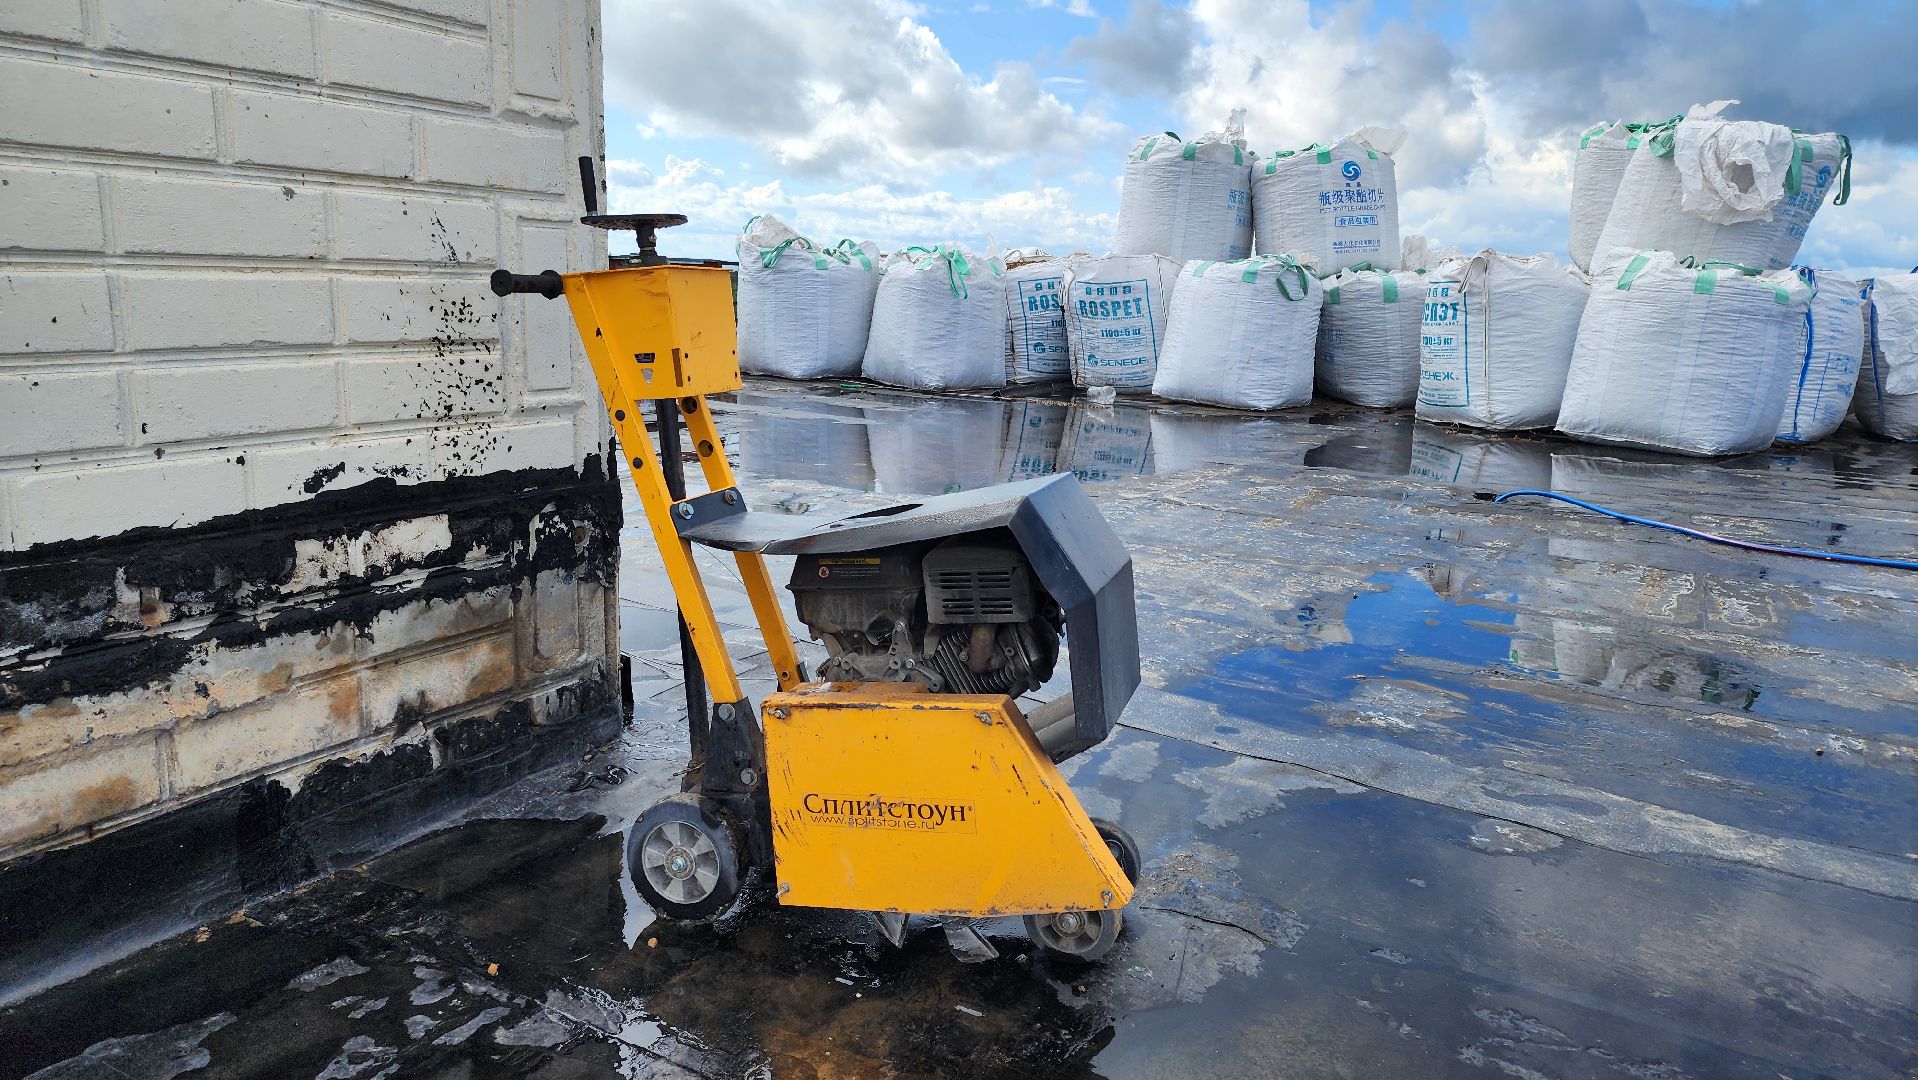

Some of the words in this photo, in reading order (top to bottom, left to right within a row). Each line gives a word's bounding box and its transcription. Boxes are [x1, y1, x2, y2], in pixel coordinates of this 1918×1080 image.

[1319, 188, 1384, 206] 瓶级聚酯切片
[1079, 298, 1142, 317] ROSPET
[1100, 356, 1147, 367] SENEGE
[811, 815, 936, 830] www.splitstone.ru
